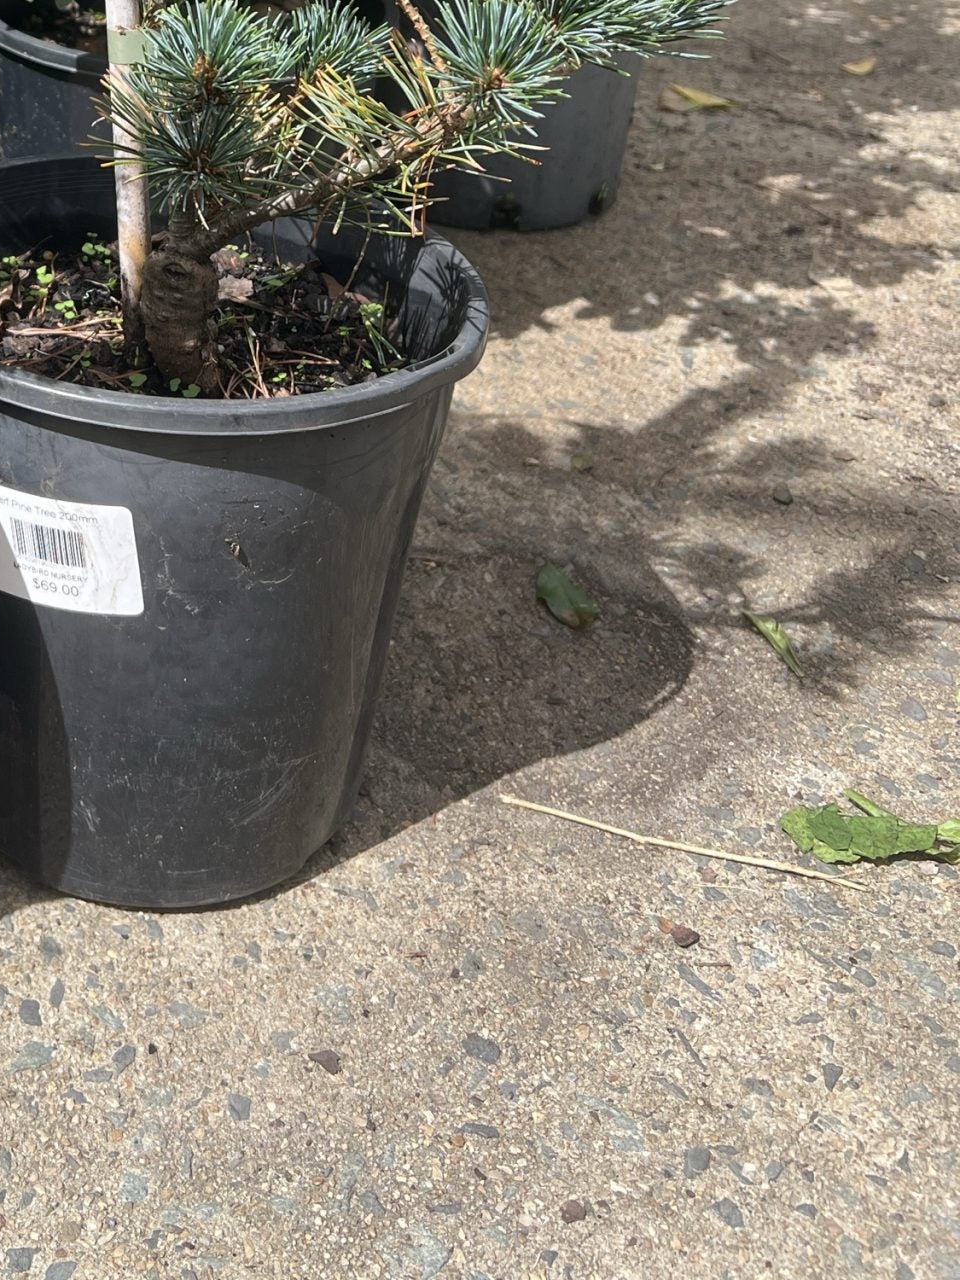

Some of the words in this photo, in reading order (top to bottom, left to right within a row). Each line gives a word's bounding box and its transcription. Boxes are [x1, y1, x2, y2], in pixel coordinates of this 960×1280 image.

[11, 499, 32, 512] Pine
[34, 505, 56, 518] Tree
[59, 511, 98, 524] 200mm
[50, 571, 88, 582] NURSERY
[33, 577, 79, 597] $69.00
